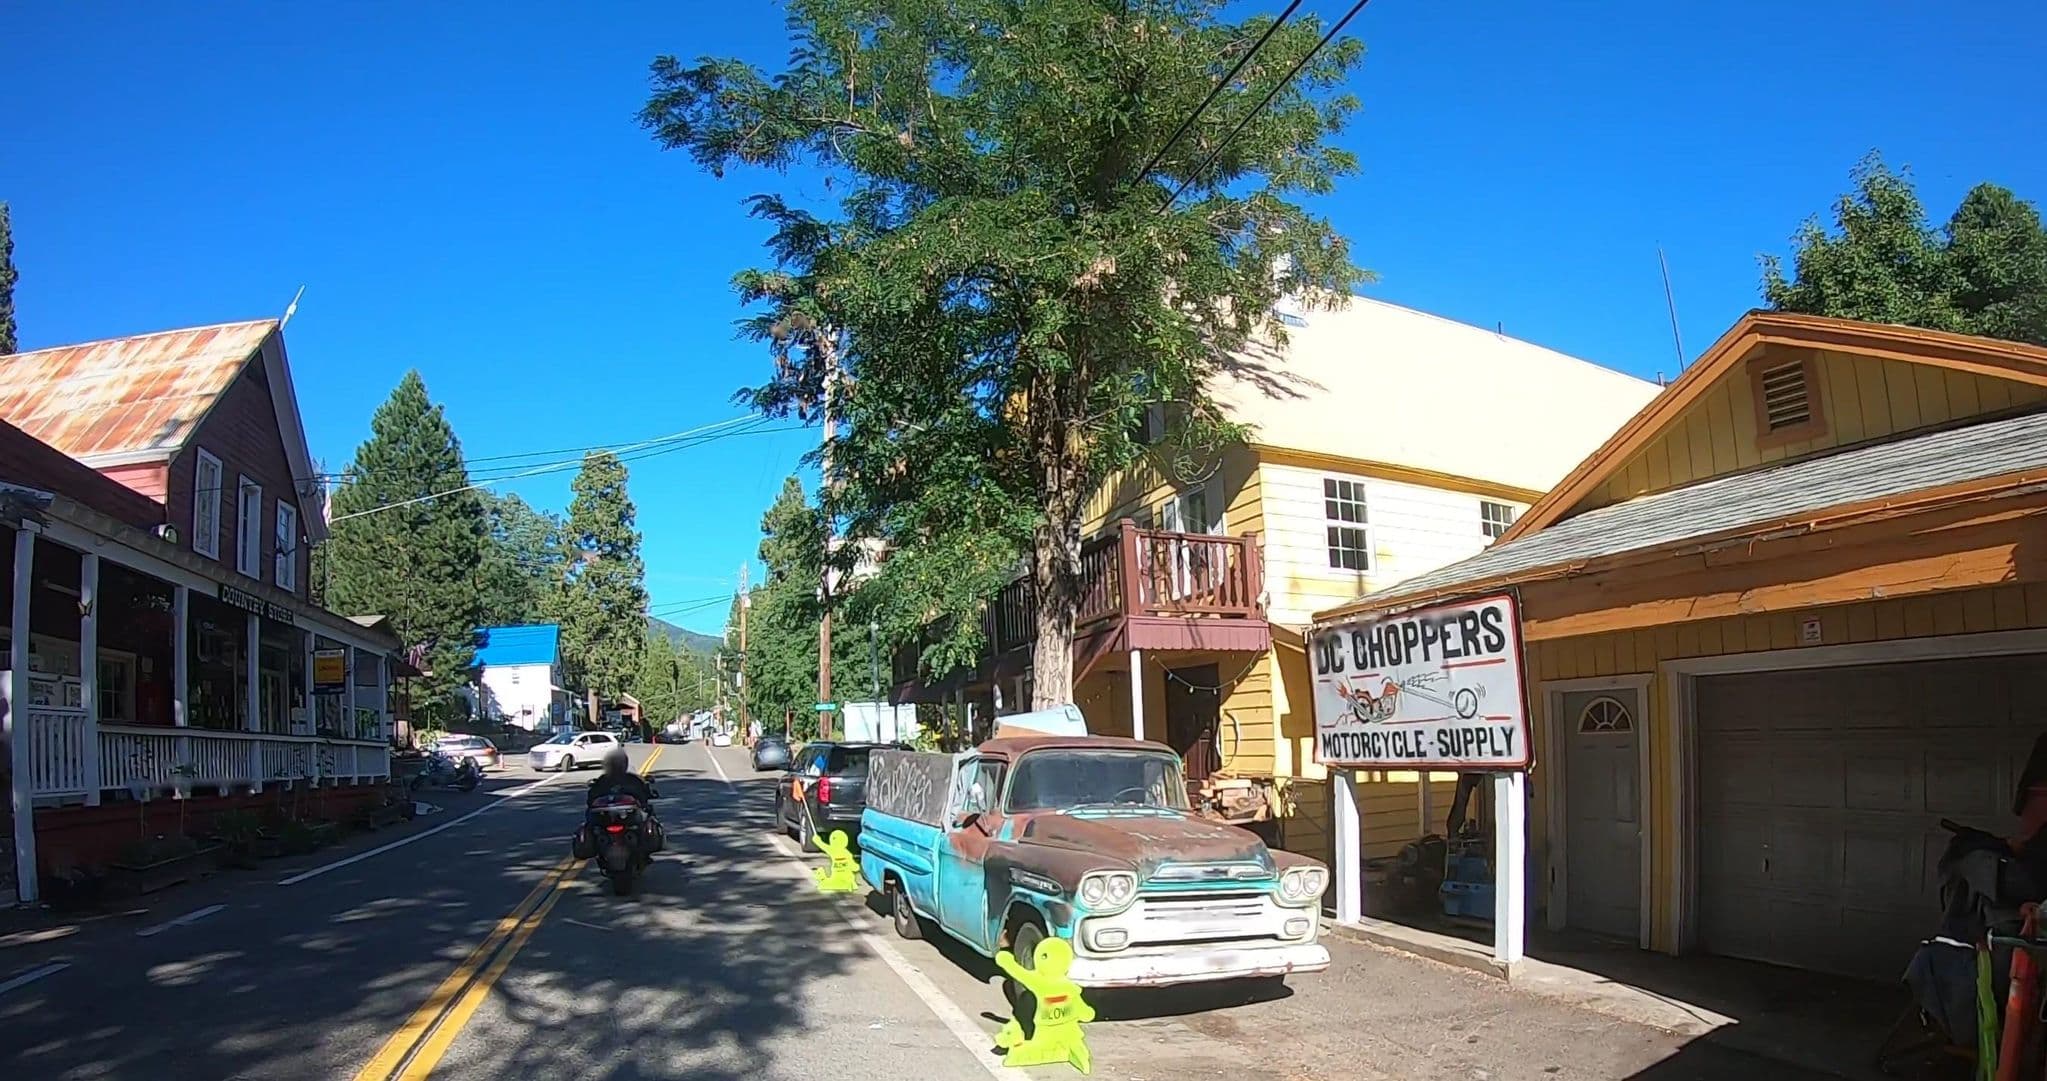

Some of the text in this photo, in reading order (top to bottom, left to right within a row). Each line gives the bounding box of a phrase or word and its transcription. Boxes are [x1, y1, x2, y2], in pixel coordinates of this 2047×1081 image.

[222, 584, 293, 625] COUNTRY STORE
[1352, 605, 1507, 671] CHOPPERS
[1321, 726, 1515, 760] MOTORCYCLE SUPPLY
